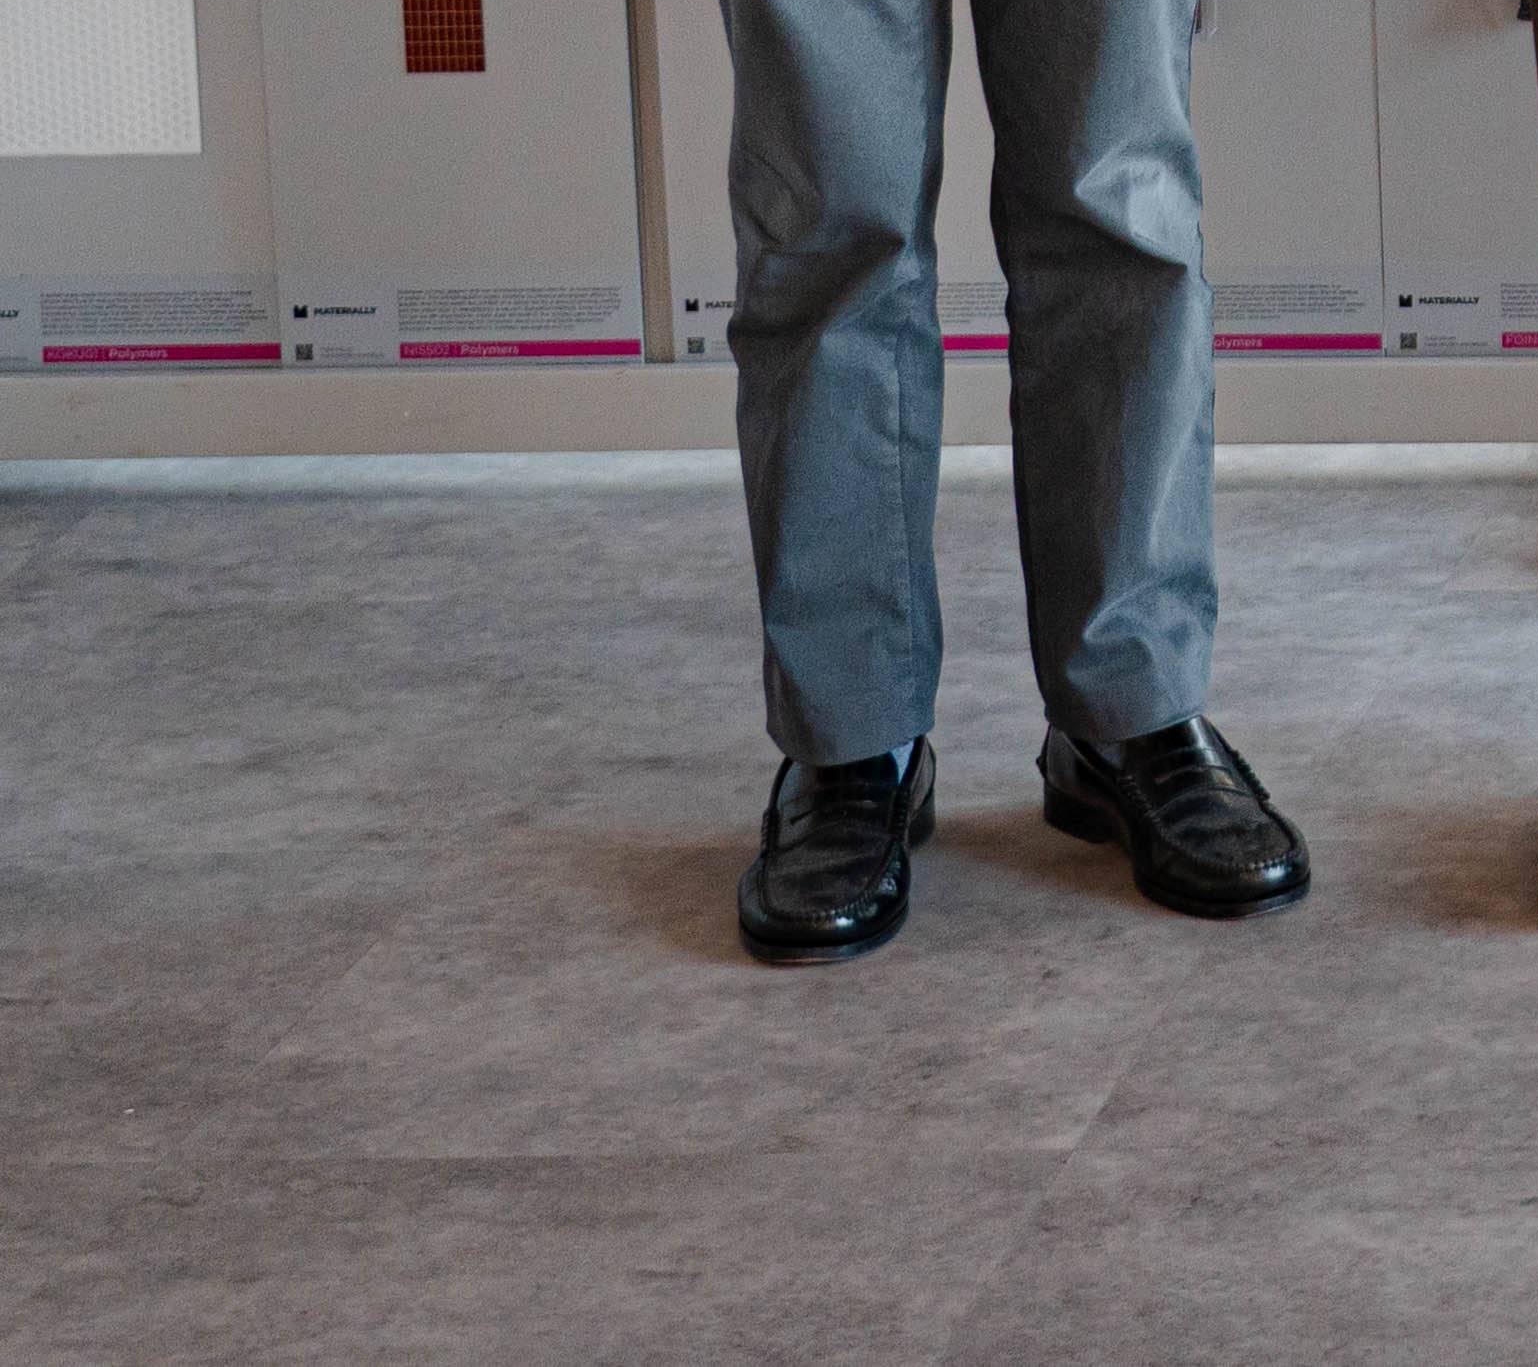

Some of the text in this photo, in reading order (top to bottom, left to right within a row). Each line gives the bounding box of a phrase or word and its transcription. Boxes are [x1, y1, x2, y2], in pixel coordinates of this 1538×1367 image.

[1418, 296, 1480, 305] MATERIALLY
[314, 306, 376, 315] MATERIALLY
[1214, 335, 1263, 348] olymers
[109, 346, 168, 359] Polymers
[460, 343, 520, 356] Polymers
